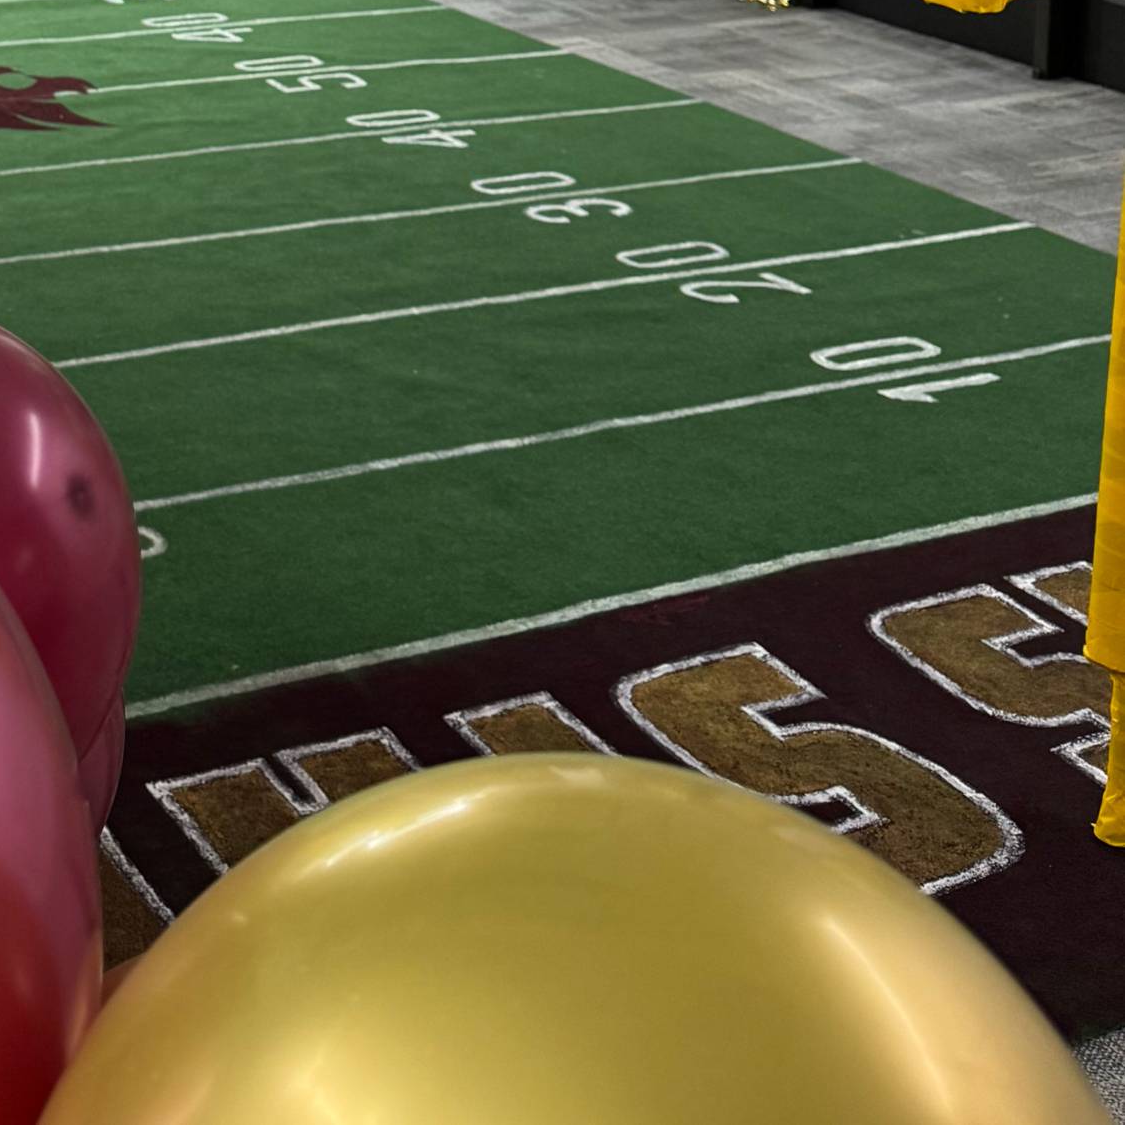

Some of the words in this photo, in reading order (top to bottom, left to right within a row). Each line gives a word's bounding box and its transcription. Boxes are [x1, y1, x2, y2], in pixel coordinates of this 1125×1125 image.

[141, 12, 253, 43] 40
[233, 54, 368, 93] 50
[346, 108, 476, 148] 40
[471, 171, 633, 224] 30
[615, 241, 813, 303] 20
[809, 336, 1002, 403] 10
